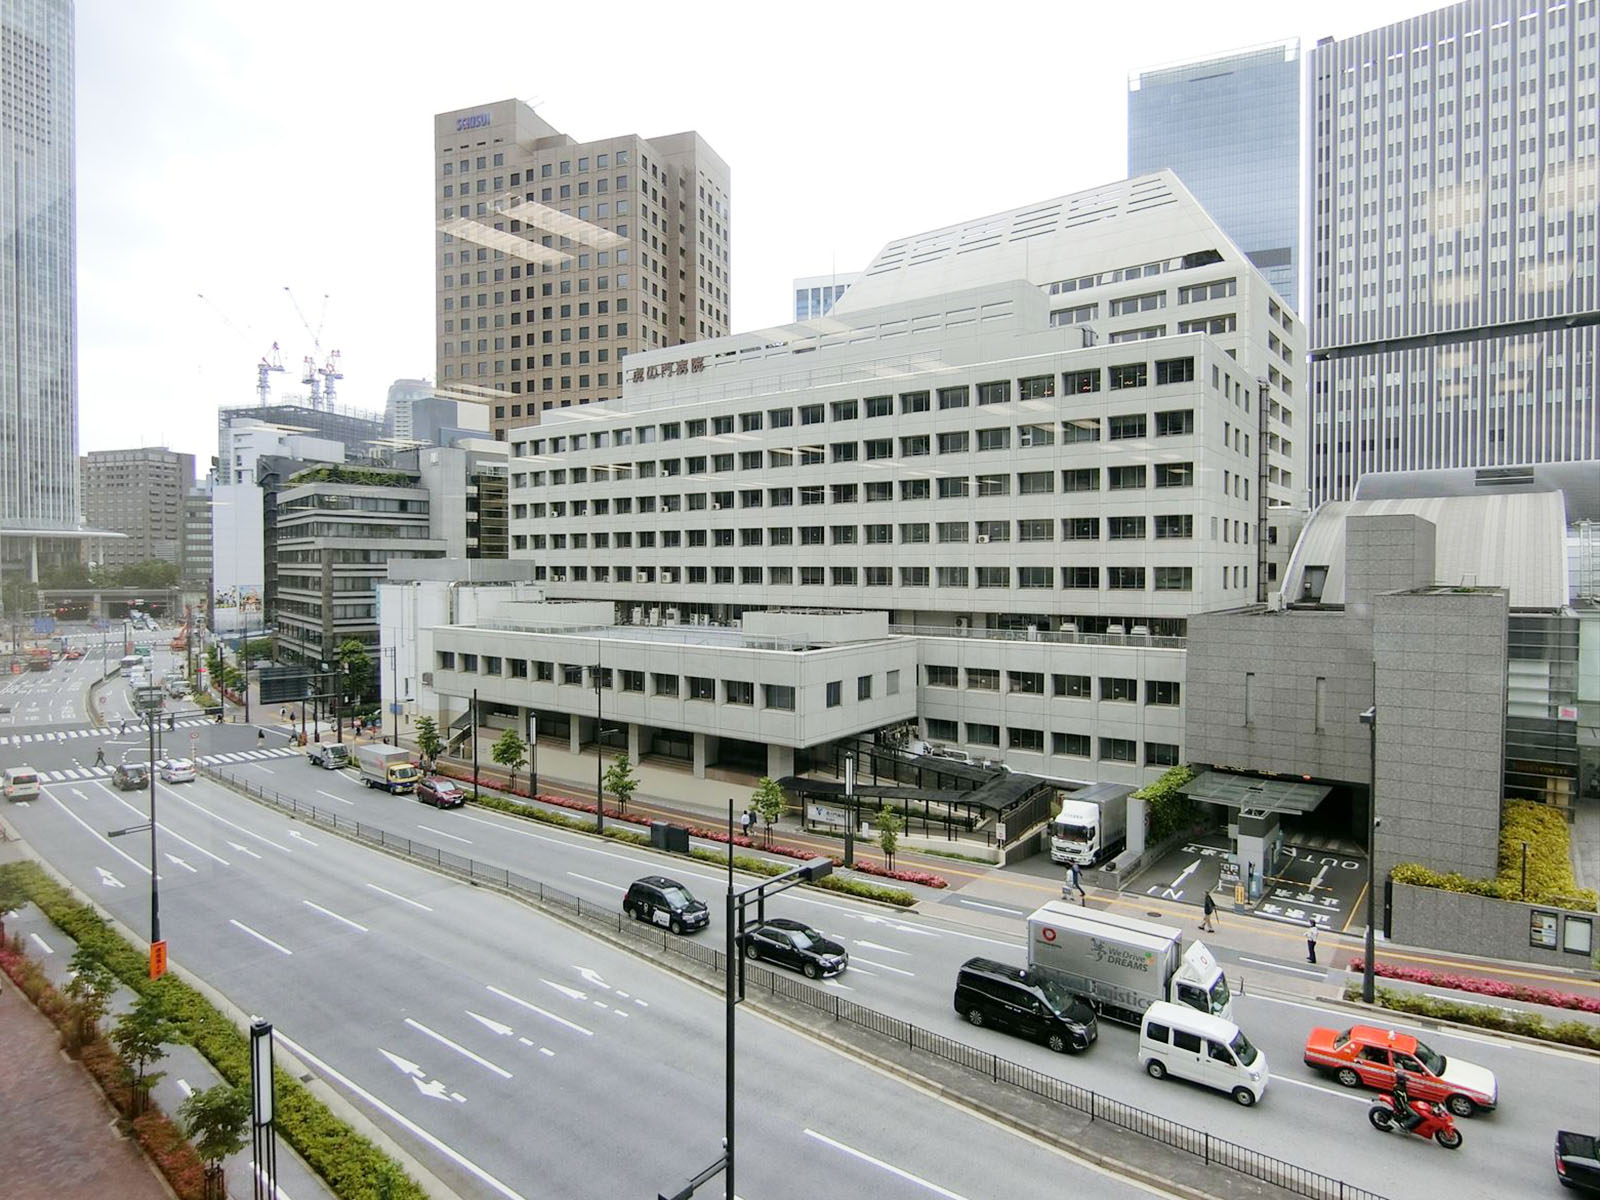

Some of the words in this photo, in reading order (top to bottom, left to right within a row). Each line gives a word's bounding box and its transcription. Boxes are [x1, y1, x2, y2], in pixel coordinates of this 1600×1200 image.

[1300, 854, 1359, 870] OUT
[1147, 885, 1184, 900] IN
[1107, 955, 1149, 972] DREAMS
